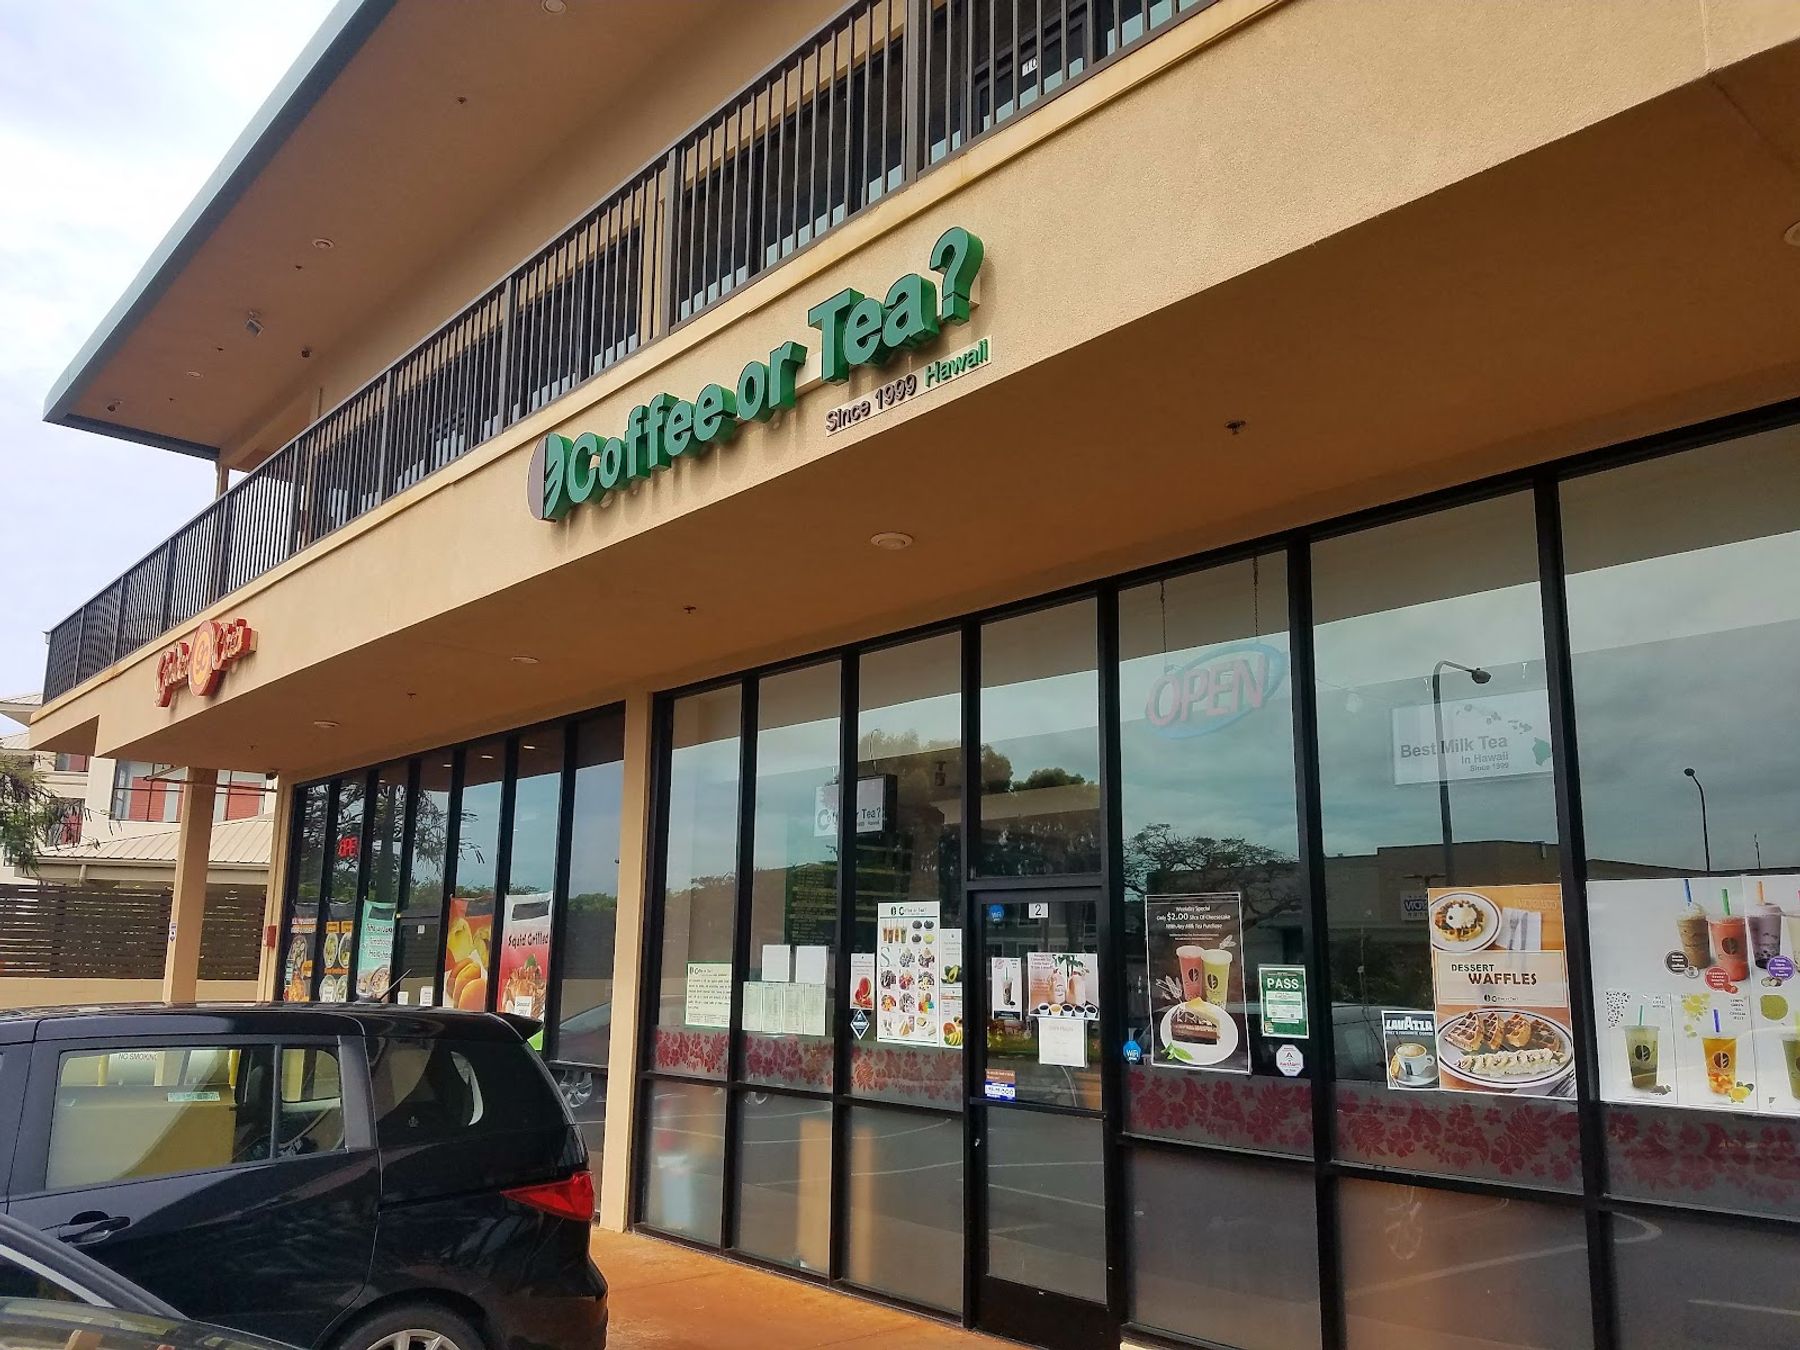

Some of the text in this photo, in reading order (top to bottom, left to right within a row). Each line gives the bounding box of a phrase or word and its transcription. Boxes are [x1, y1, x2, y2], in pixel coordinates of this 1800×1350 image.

[567, 226, 985, 504] Coffee or Tea?
[826, 339, 989, 432] Since 1999 Hawaii
[1146, 651, 1269, 726] OPEN
[1401, 736, 1508, 758] Best Milk Tea
[1462, 752, 1509, 765] In Hawaii
[861, 807, 881, 819] Tea?
[1035, 904, 1042, 916] 2
[1167, 912, 1188, 921] $2.00
[1451, 964, 1495, 972] DESSERT
[1267, 978, 1299, 989] PASS
[1468, 973, 1537, 985] WAFFLES
[1385, 1016, 1433, 1031] LAVAZZA
